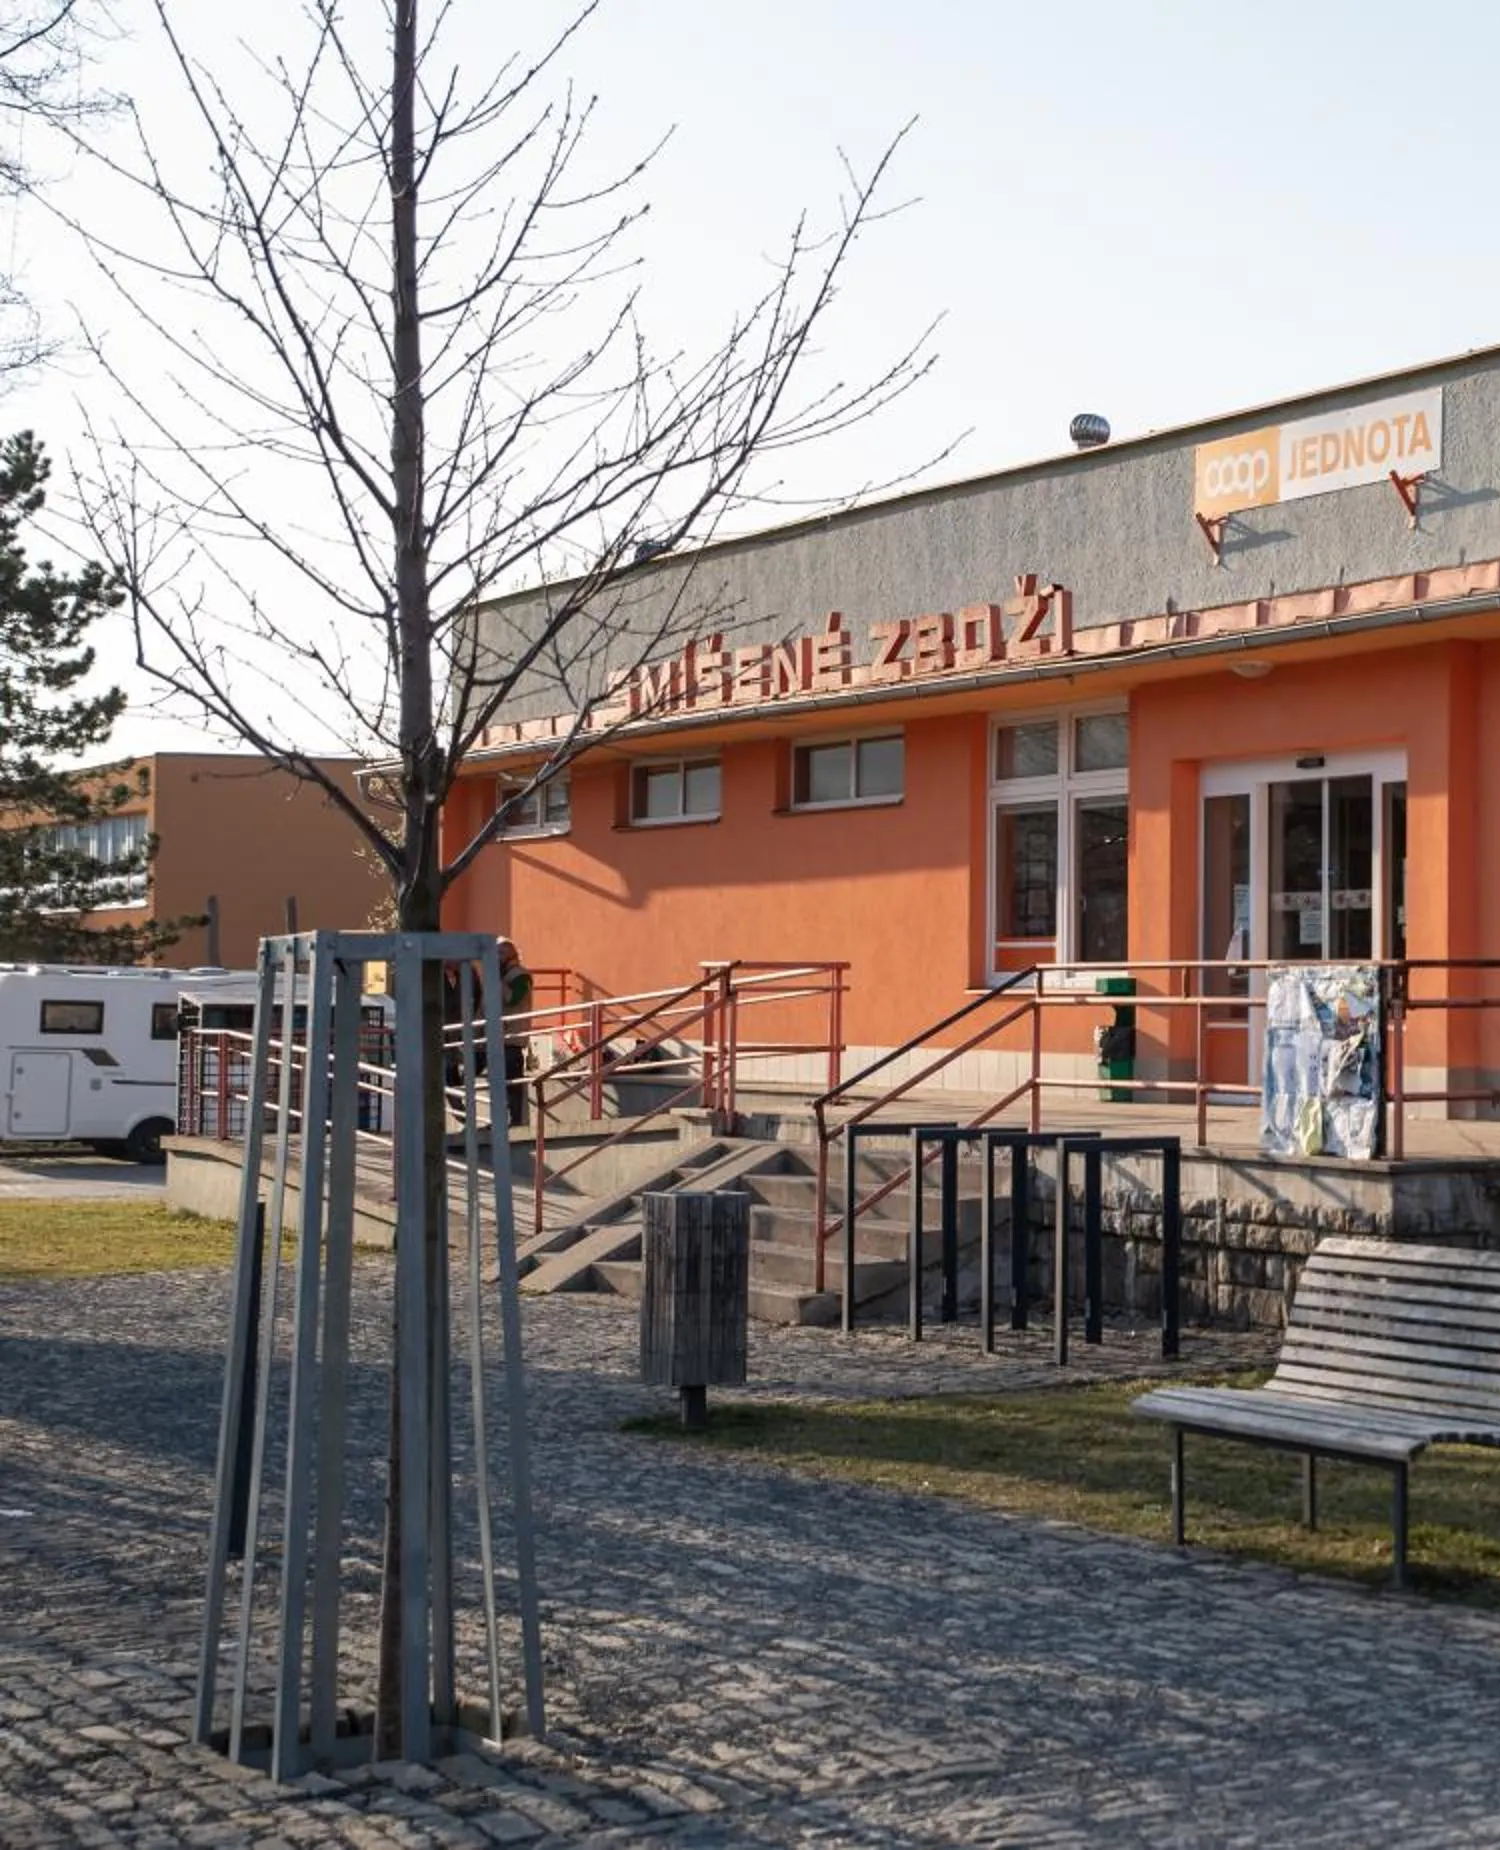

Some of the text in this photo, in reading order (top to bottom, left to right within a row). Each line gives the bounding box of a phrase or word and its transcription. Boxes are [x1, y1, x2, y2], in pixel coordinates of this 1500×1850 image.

[1205, 410, 1433, 500] coop JEDNOTA
[868, 573, 1073, 680] ZBOŽÍ
